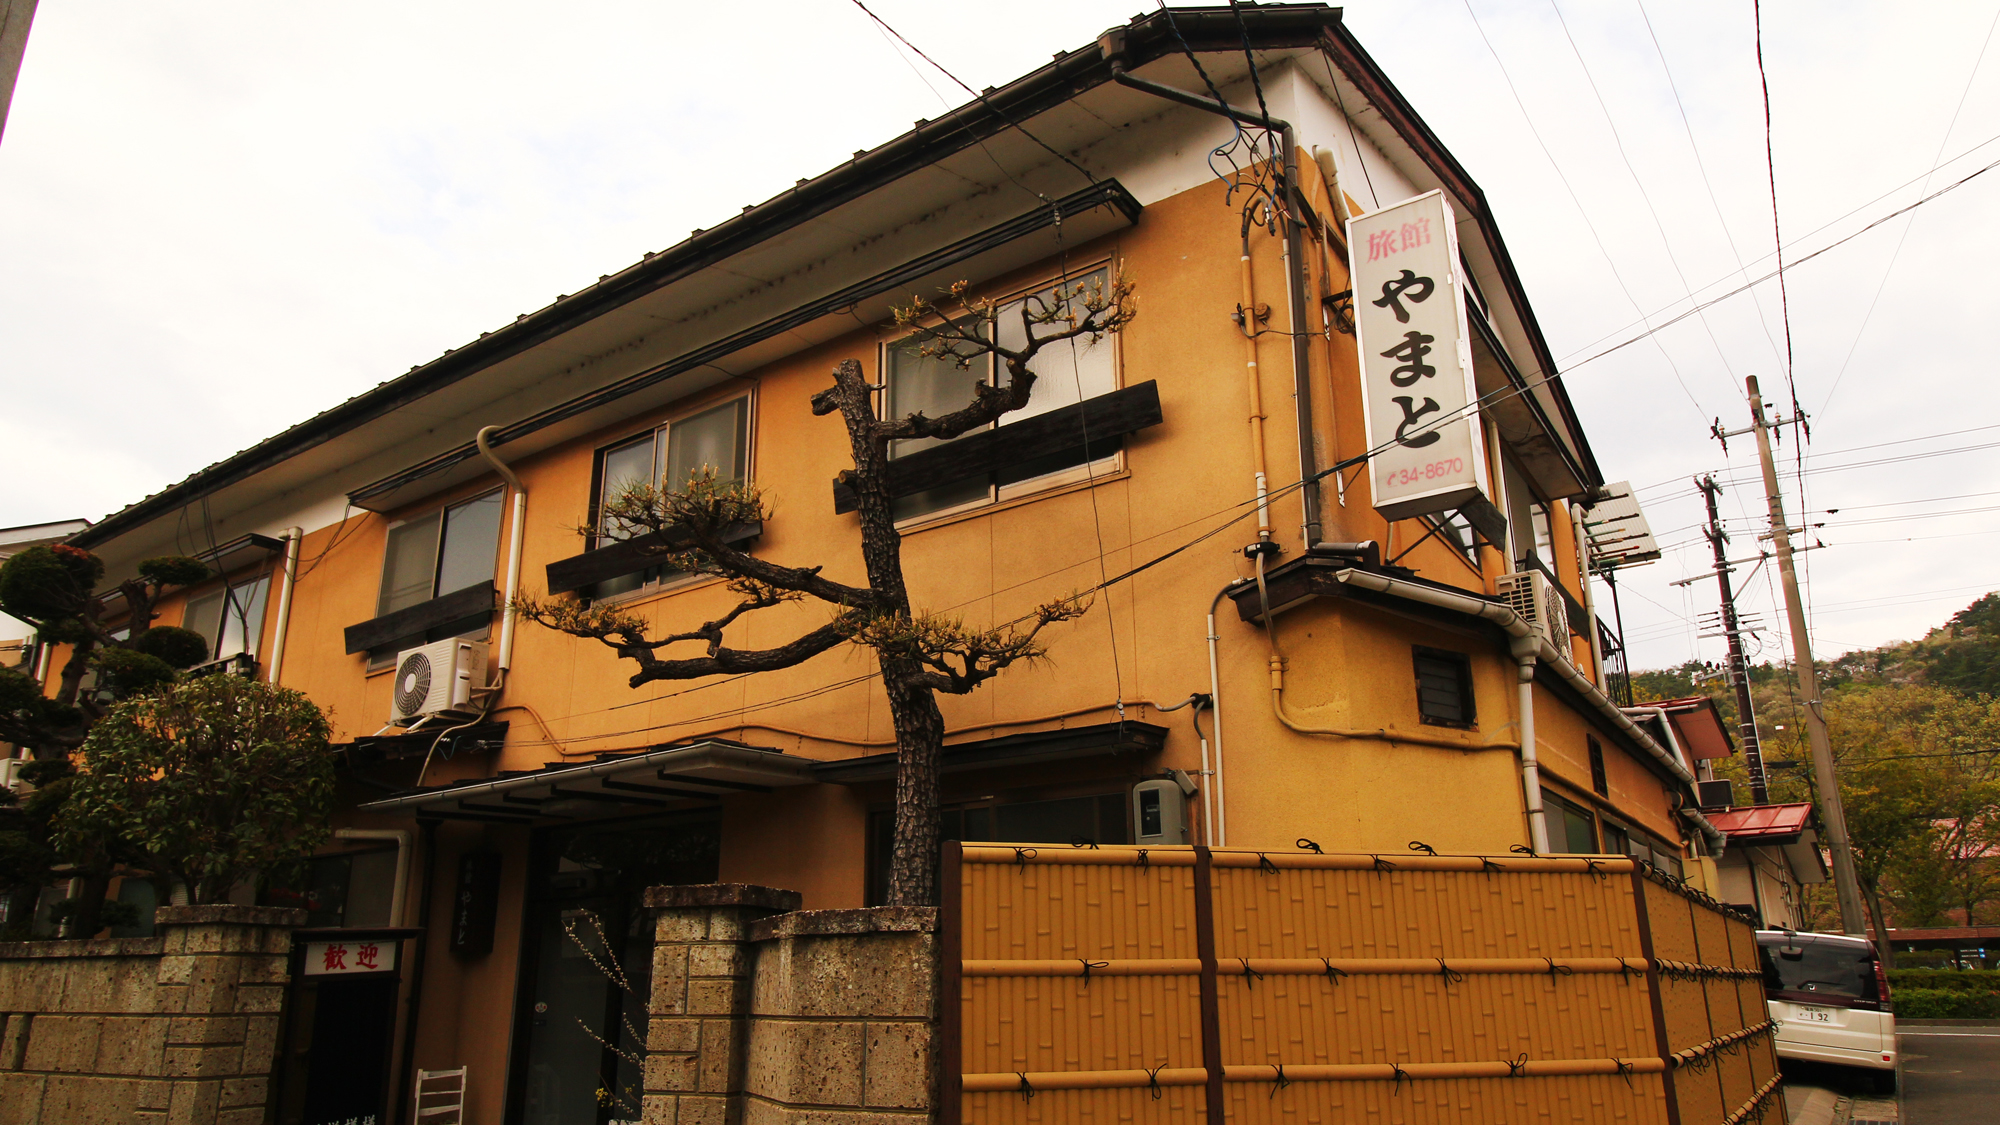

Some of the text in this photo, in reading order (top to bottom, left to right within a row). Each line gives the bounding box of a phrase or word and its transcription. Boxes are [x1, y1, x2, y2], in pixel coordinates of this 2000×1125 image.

[1366, 217, 1431, 262] 旅館
[1372, 269, 1440, 449] やまと
[1399, 457, 1463, 485] 34-8670
[323, 943, 379, 971] 歓迎
